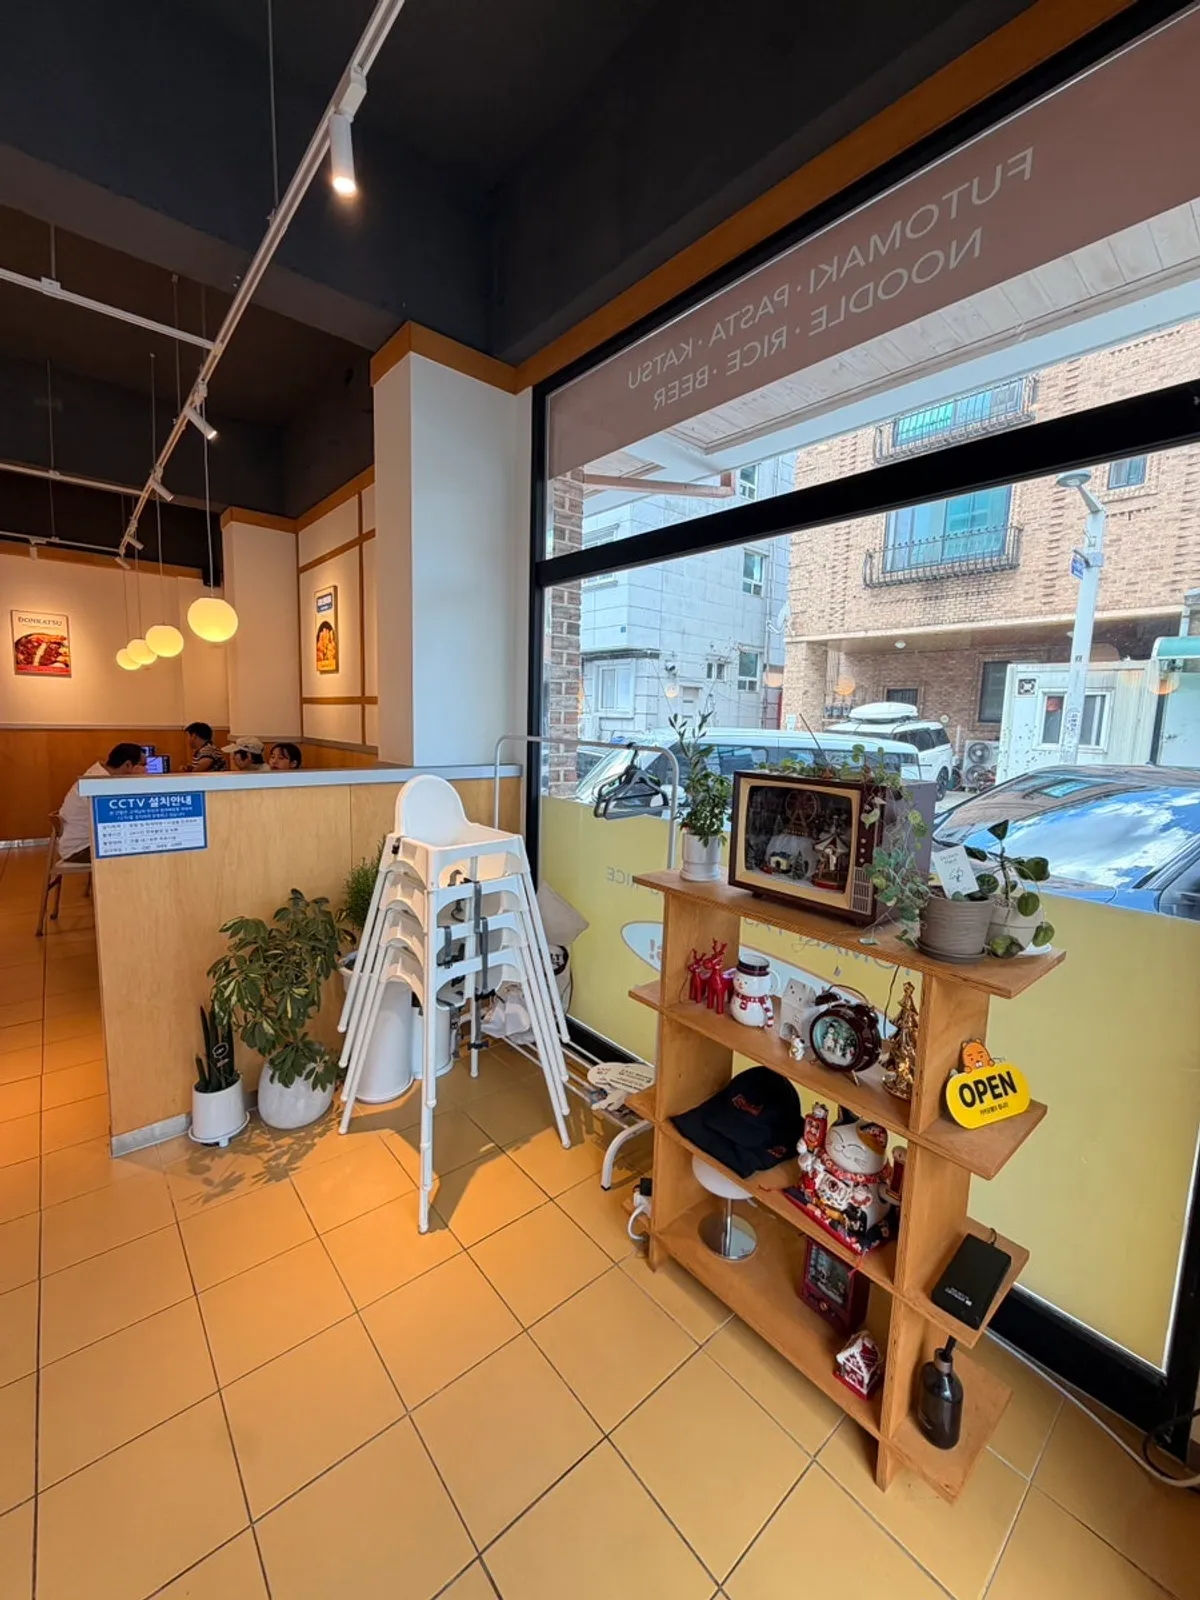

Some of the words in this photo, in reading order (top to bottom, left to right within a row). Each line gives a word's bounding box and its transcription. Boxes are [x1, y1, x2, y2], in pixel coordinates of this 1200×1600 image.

[109, 798, 145, 809] CCTV
[149, 795, 192, 807] 설치안내
[958, 1070, 1018, 1109] OPEN
